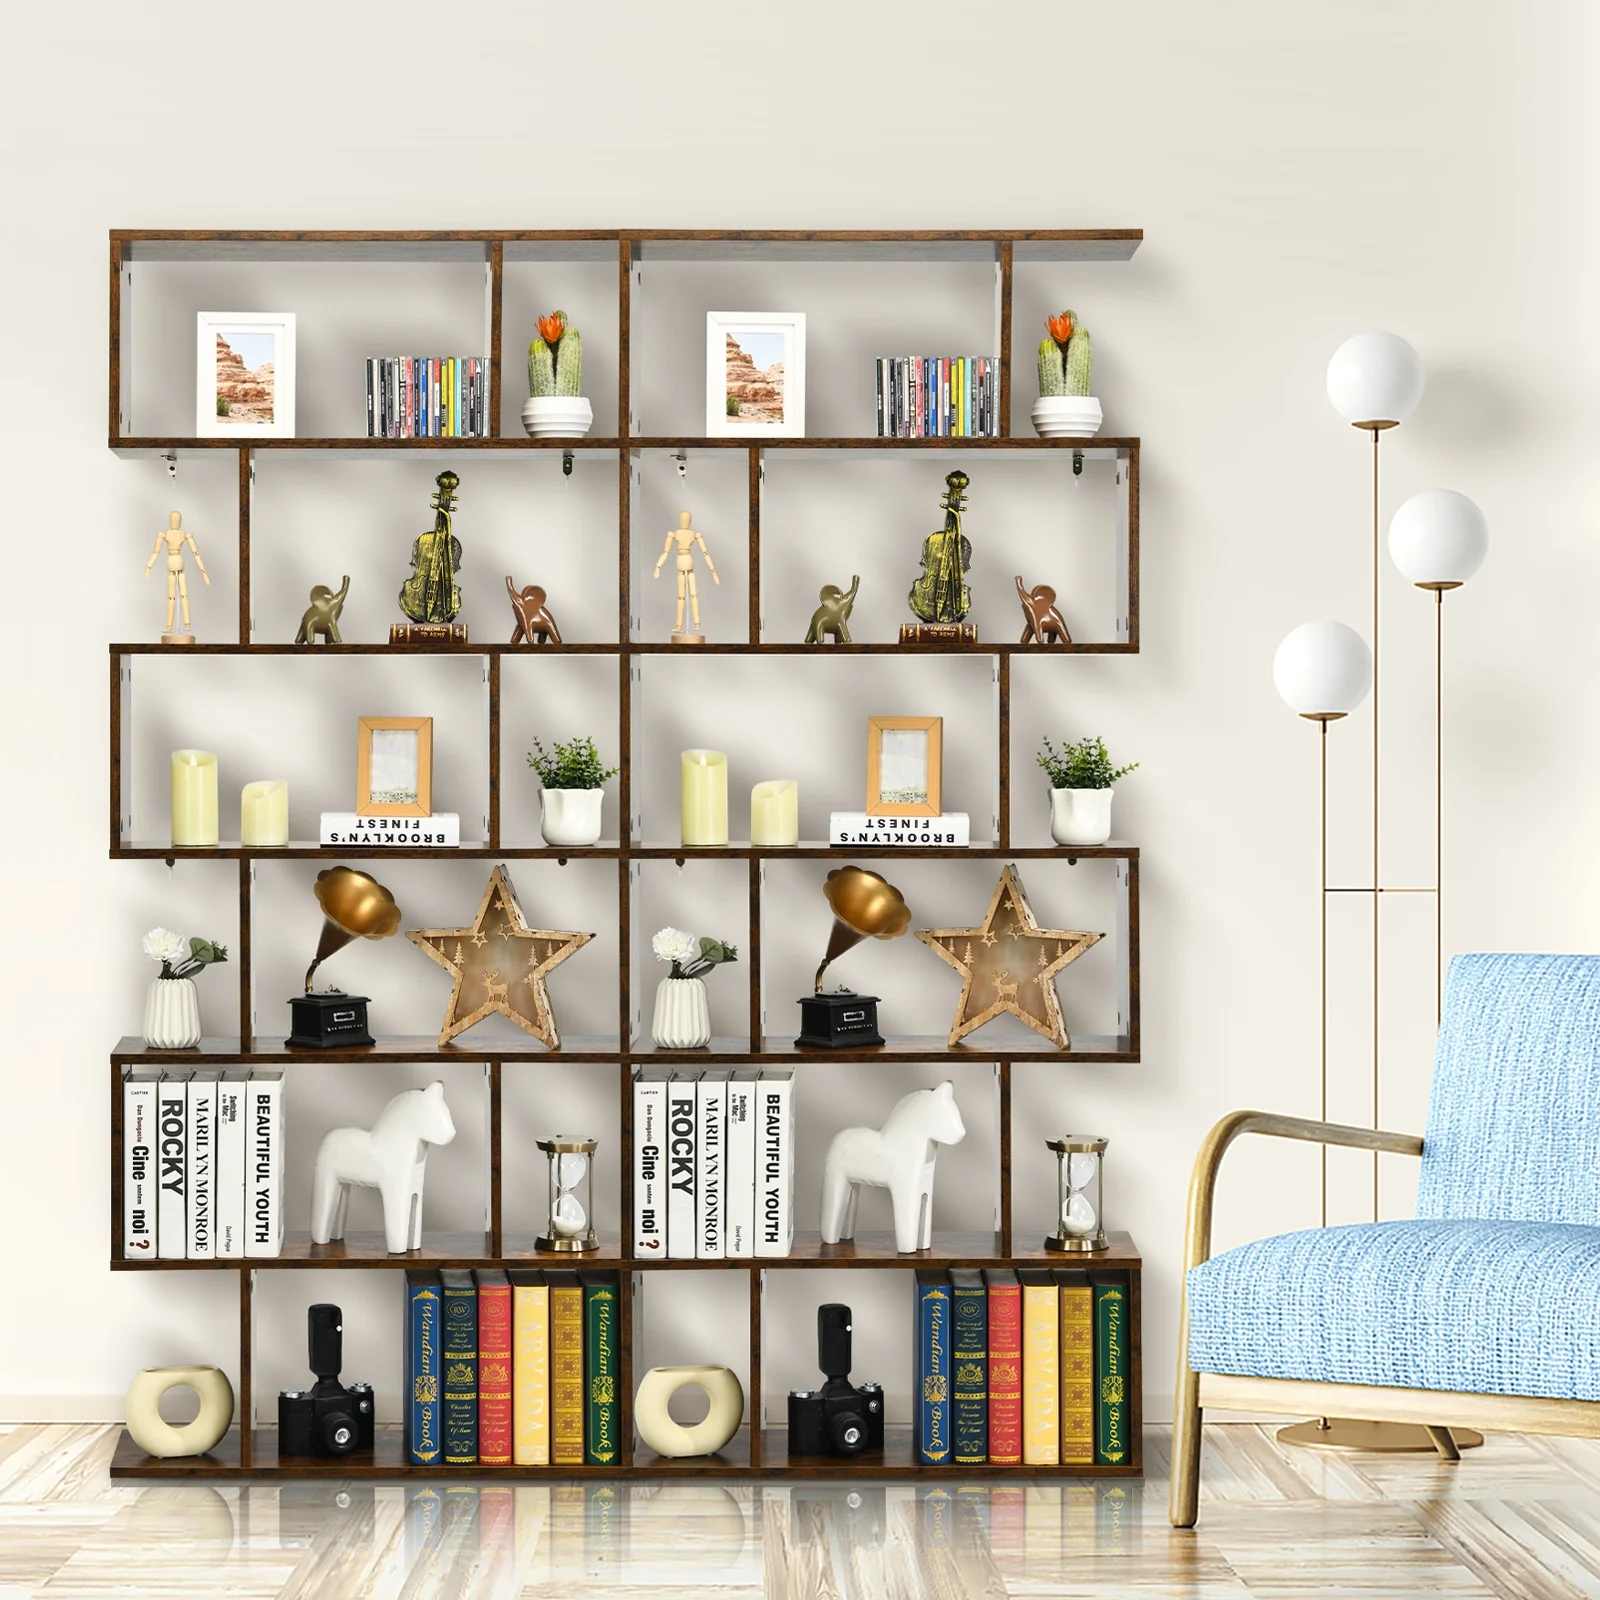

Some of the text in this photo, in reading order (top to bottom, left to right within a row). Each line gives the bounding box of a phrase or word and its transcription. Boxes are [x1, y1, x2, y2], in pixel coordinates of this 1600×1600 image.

[356, 819, 419, 829] FINEST
[866, 819, 929, 828] FINEST
[162, 1100, 185, 1197] ROCKY
[227, 1096, 237, 1122] Switching
[645, 1117, 653, 1142] Dungaciu
[672, 1100, 695, 1197] ROCKY
[732, 1105, 740, 1116] Mac
[737, 1095, 747, 1121] Switching
[132, 1146, 149, 1180] Cine
[196, 1099, 208, 1251] MARILYN MONROE
[256, 1095, 270, 1242] BEAUTIFUL YOUTH
[642, 1146, 659, 1180] Cine
[705, 1098, 718, 1251] MARILYN MONROE
[765, 1095, 780, 1242] BEAUTIFUL YOUTH
[132, 1210, 149, 1233] noi
[642, 1210, 658, 1233] noi
[420, 1303, 434, 1450] Wandian Book
[522, 1319, 544, 1434] ARVADA
[597, 1303, 612, 1451] Wandian Book
[930, 1303, 944, 1450] Wandian Book
[1031, 1318, 1054, 1433] ARVADA
[1107, 1303, 1122, 1451] Wandian Book
